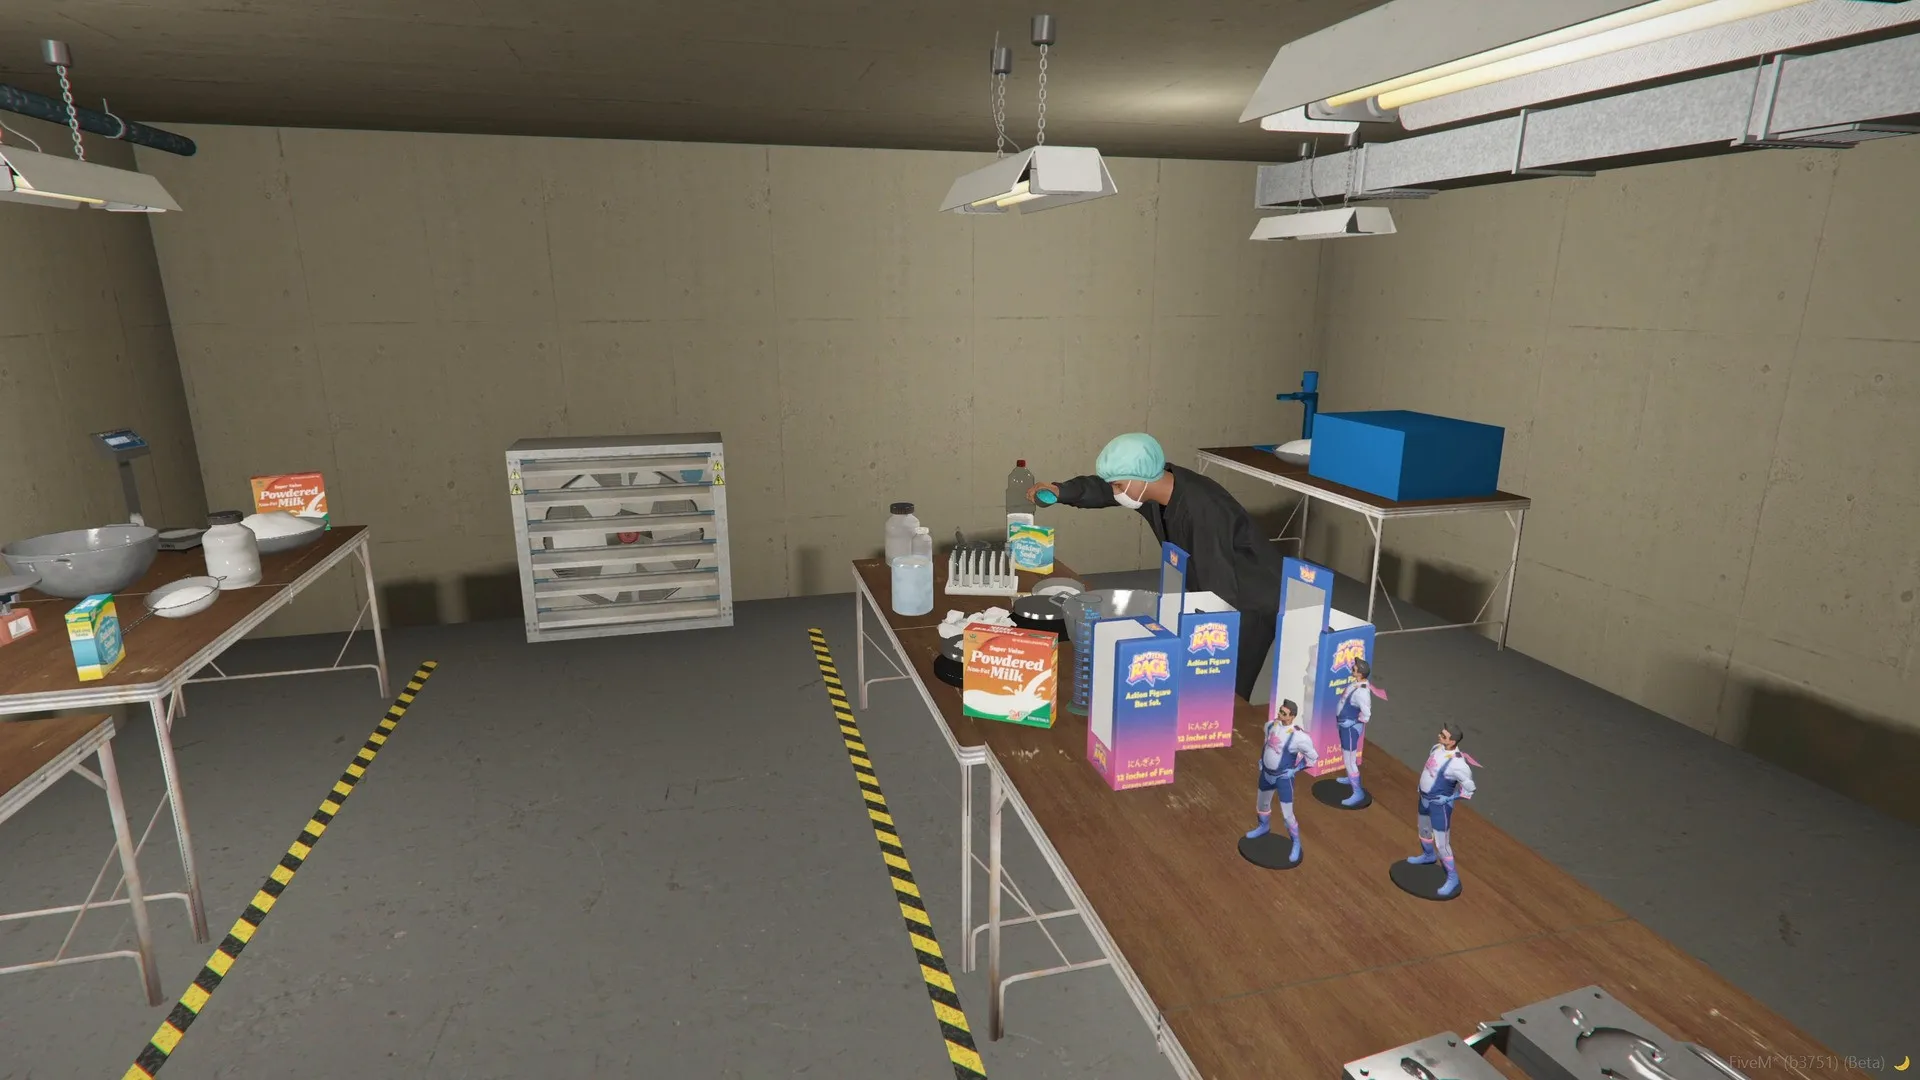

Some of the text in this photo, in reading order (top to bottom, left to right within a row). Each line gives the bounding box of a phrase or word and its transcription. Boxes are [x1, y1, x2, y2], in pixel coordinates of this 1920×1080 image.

[260, 486, 318, 500] Powdered
[278, 497, 305, 508] Milk
[1190, 629, 1228, 651] RAGE
[989, 645, 1025, 655] Super Value
[970, 649, 1045, 672] Powdered
[1186, 659, 1209, 667] Action
[967, 665, 1024, 683] Non-Fat Milk
[1130, 658, 1168, 682] RAGE
[1125, 689, 1172, 700] Action Figure
[1217, 731, 1231, 739] Fun
[1150, 768, 1158, 777] of
[1159, 768, 1173, 776] Fun
